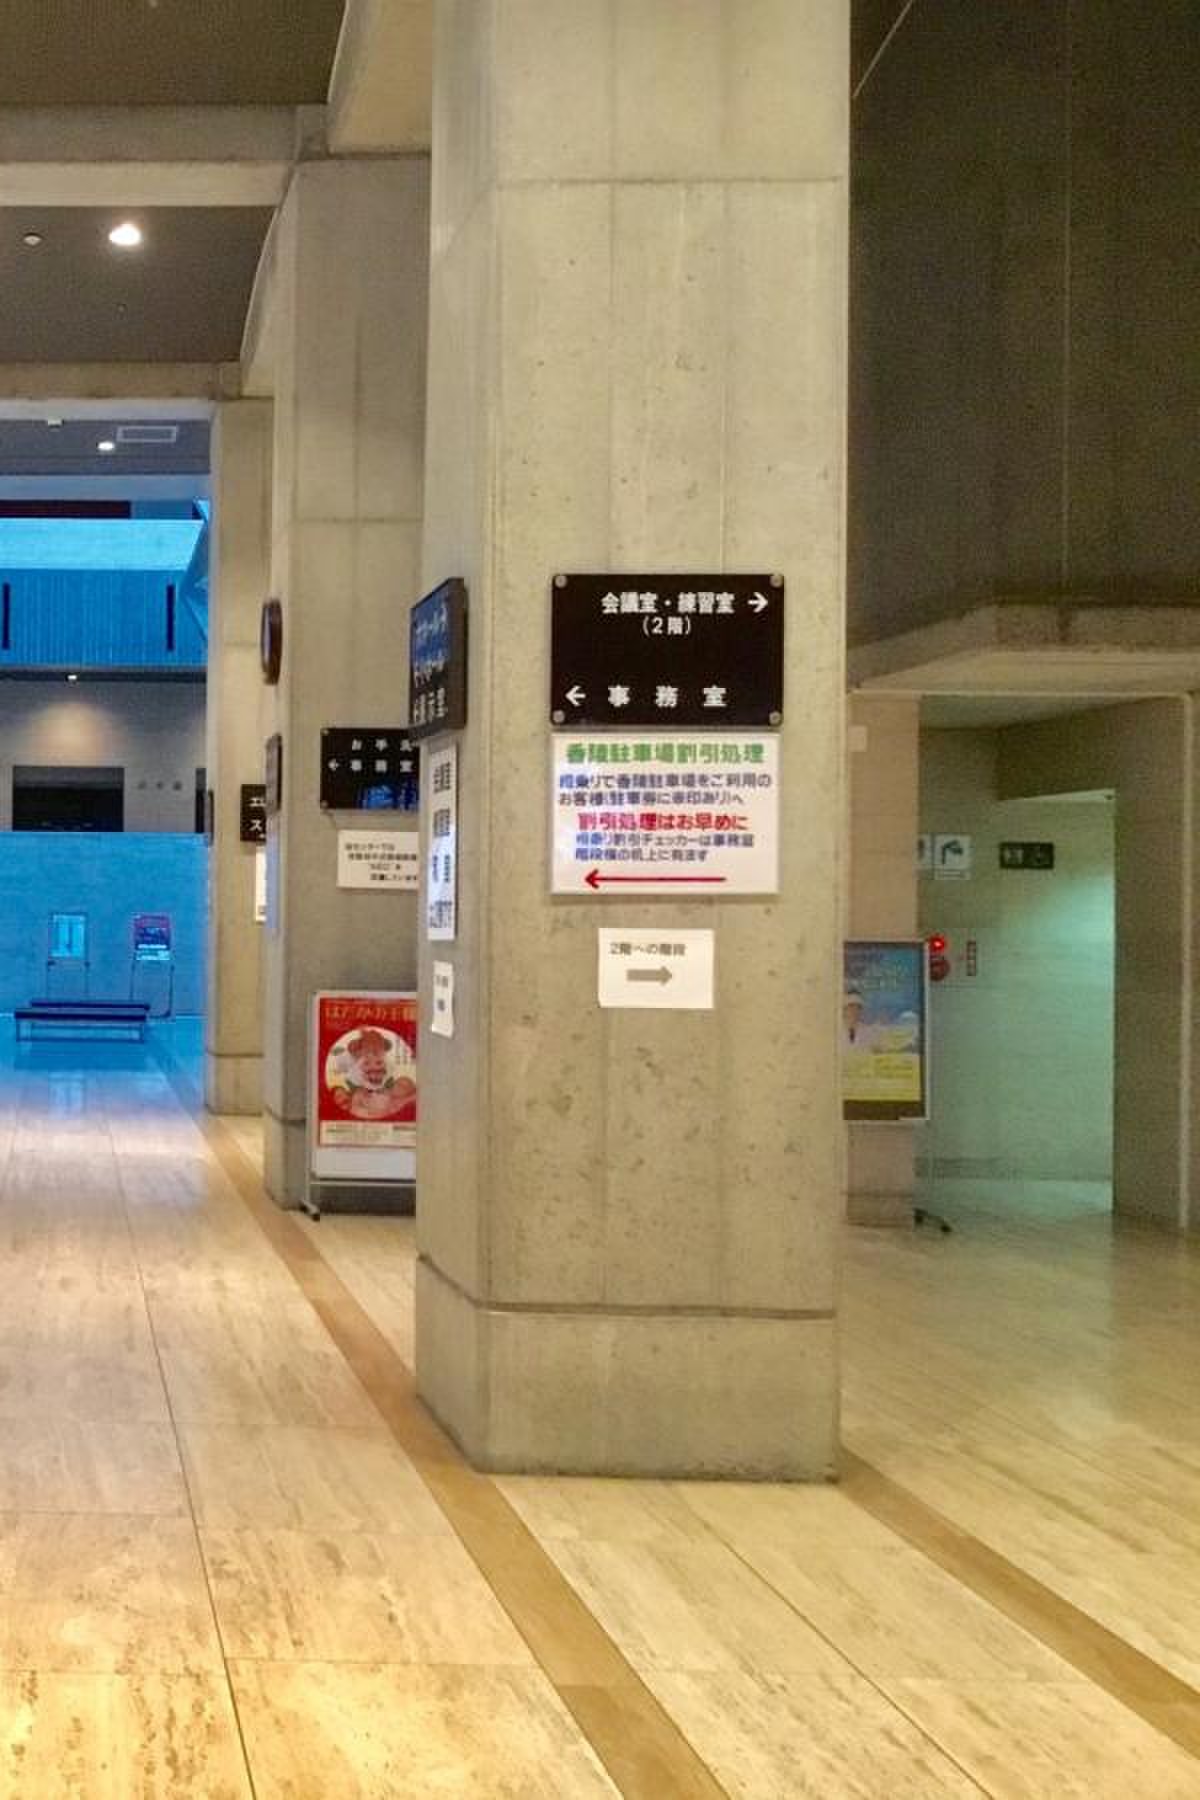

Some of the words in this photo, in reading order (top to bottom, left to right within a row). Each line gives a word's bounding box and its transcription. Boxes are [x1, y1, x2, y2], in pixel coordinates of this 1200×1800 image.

[601, 591, 735, 614] 会議室・練習室
[607, 685, 727, 708] 事務室
